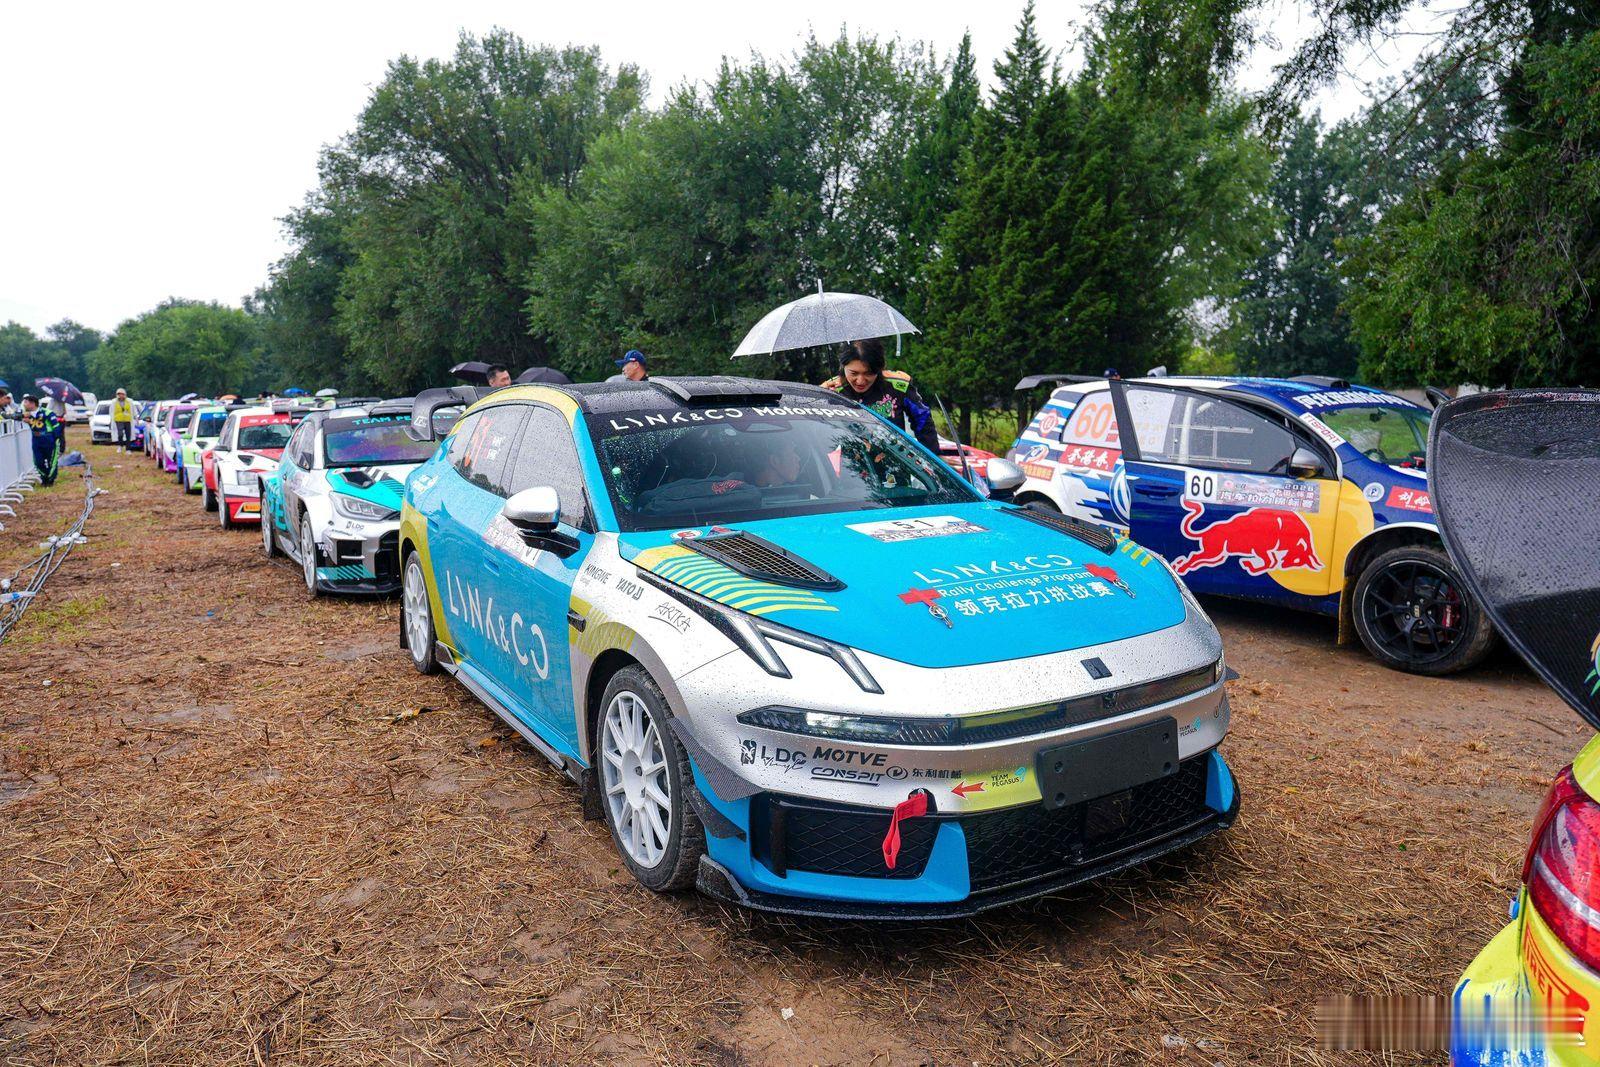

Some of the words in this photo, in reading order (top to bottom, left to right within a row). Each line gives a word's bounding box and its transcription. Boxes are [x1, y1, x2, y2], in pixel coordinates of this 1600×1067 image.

[752, 406, 860, 418] Motorsport
[1075, 402, 1113, 439] 60
[1191, 475, 1213, 497] 60
[891, 519, 934, 530] 51
[940, 584, 974, 598] Rally
[975, 576, 1042, 592] Challenge
[1043, 570, 1095, 584] Program
[954, 581, 1114, 616] 领克拉力挑战赛
[760, 745, 807, 765] LDC
[812, 746, 888, 767] MOTVE
[811, 767, 885, 782] CONSPIT
[991, 773, 1009, 782] TEAM
[992, 777, 1020, 788] PEGASUS
